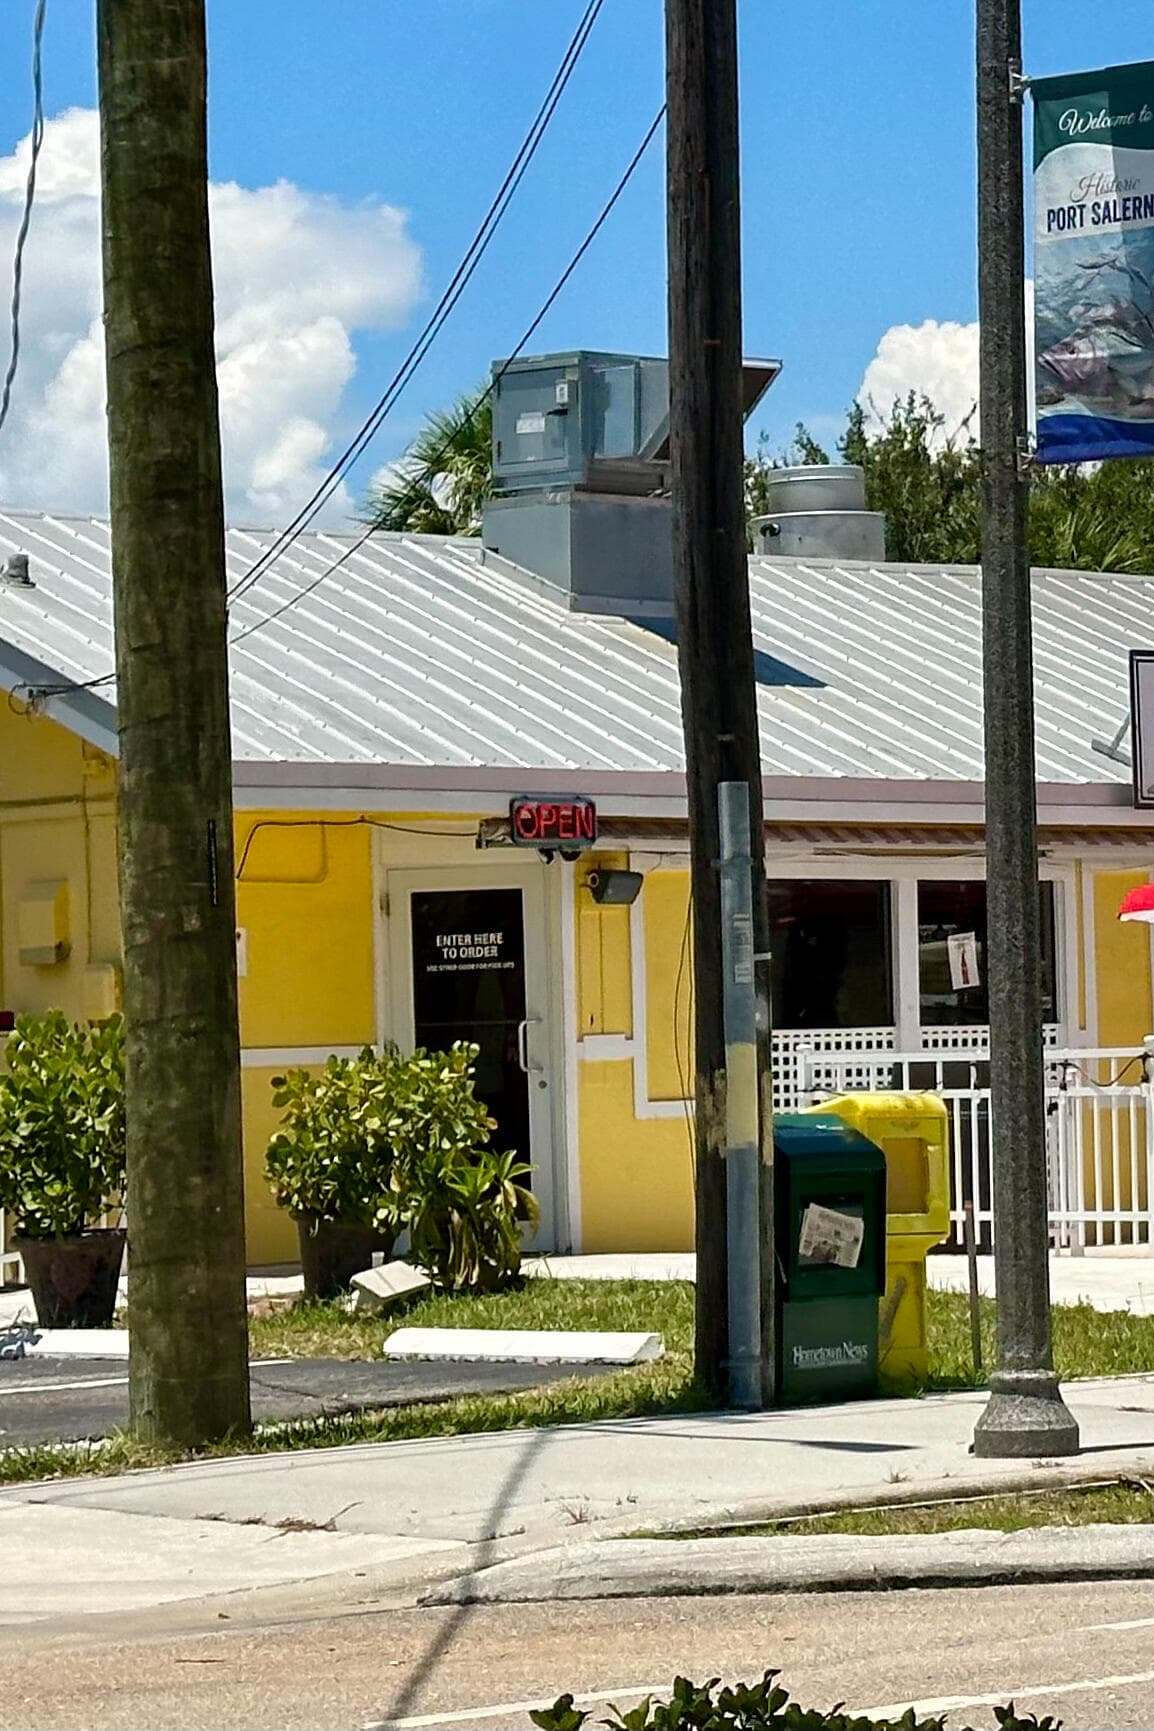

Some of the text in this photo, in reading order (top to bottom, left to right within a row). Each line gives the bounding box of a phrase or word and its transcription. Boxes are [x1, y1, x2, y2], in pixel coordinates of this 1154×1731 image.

[1059, 104, 1153, 135] Welcome to
[1070, 172, 1141, 202] Historic
[1047, 203, 1087, 233] PORT
[516, 803, 593, 838] OPEN
[436, 932, 504, 947] ENTER HERE
[442, 945, 498, 959] TO ORDER
